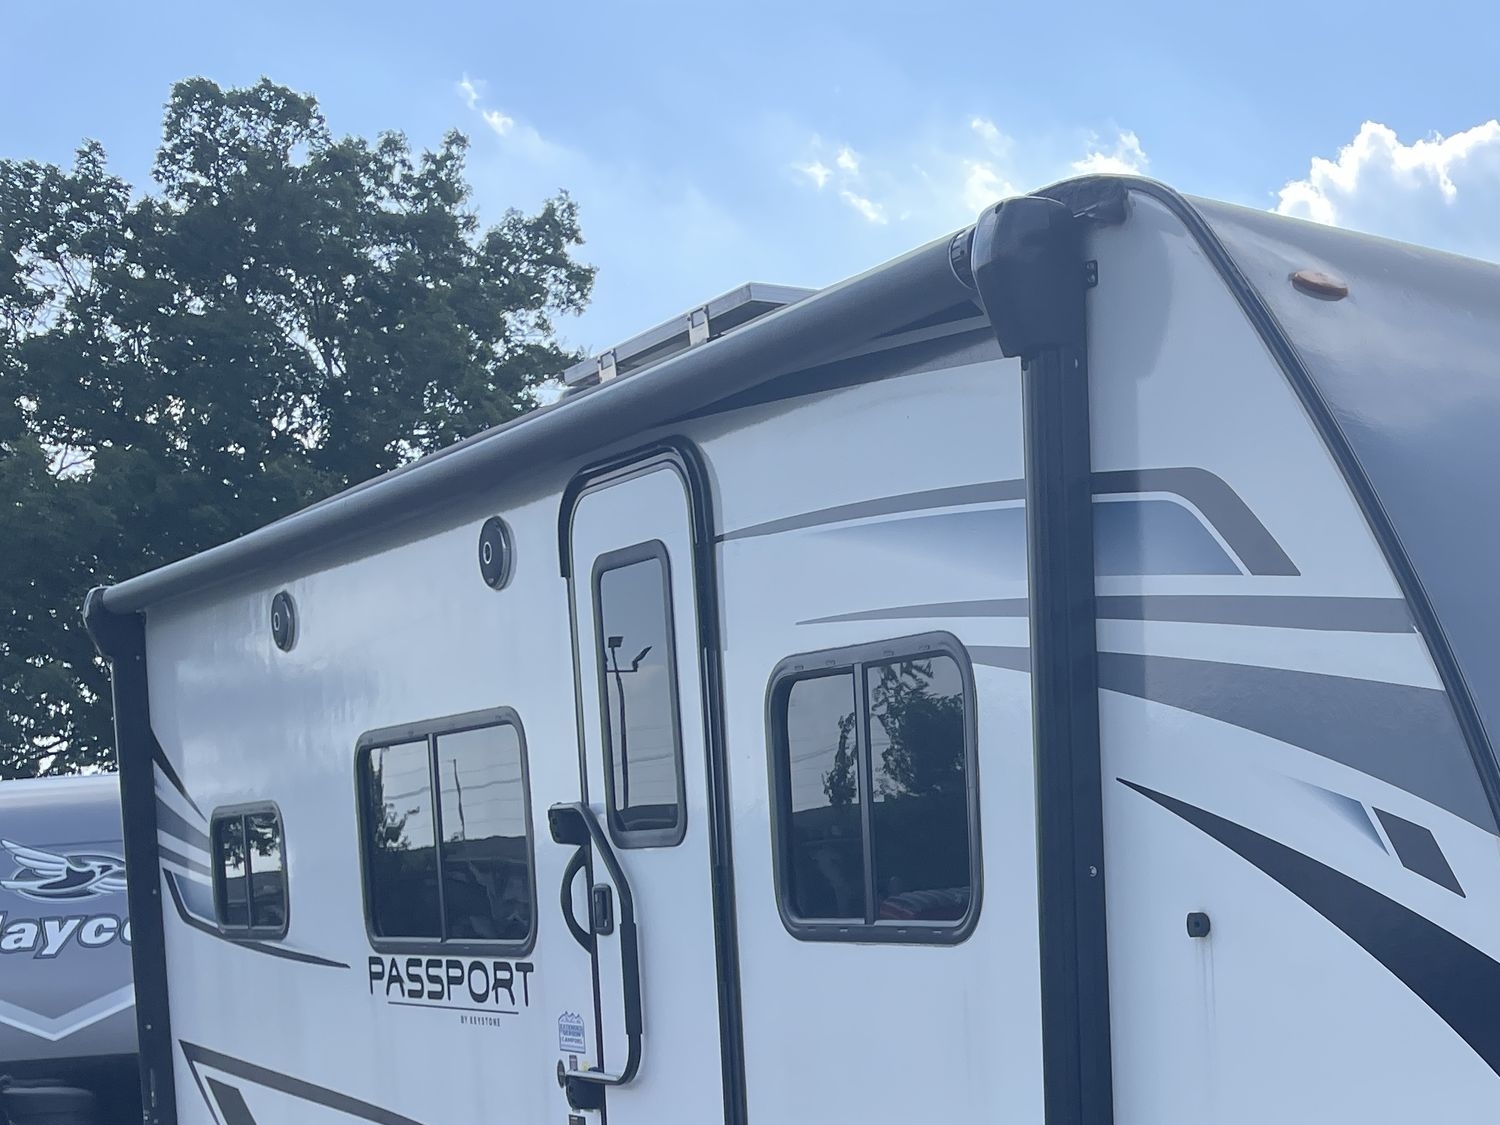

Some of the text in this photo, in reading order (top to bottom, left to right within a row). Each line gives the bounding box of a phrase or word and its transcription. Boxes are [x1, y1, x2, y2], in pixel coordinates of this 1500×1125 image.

[0, 911, 132, 959] ayc
[368, 956, 534, 1007] PASSPORT
[469, 1015, 501, 1028] KEYSTONE
